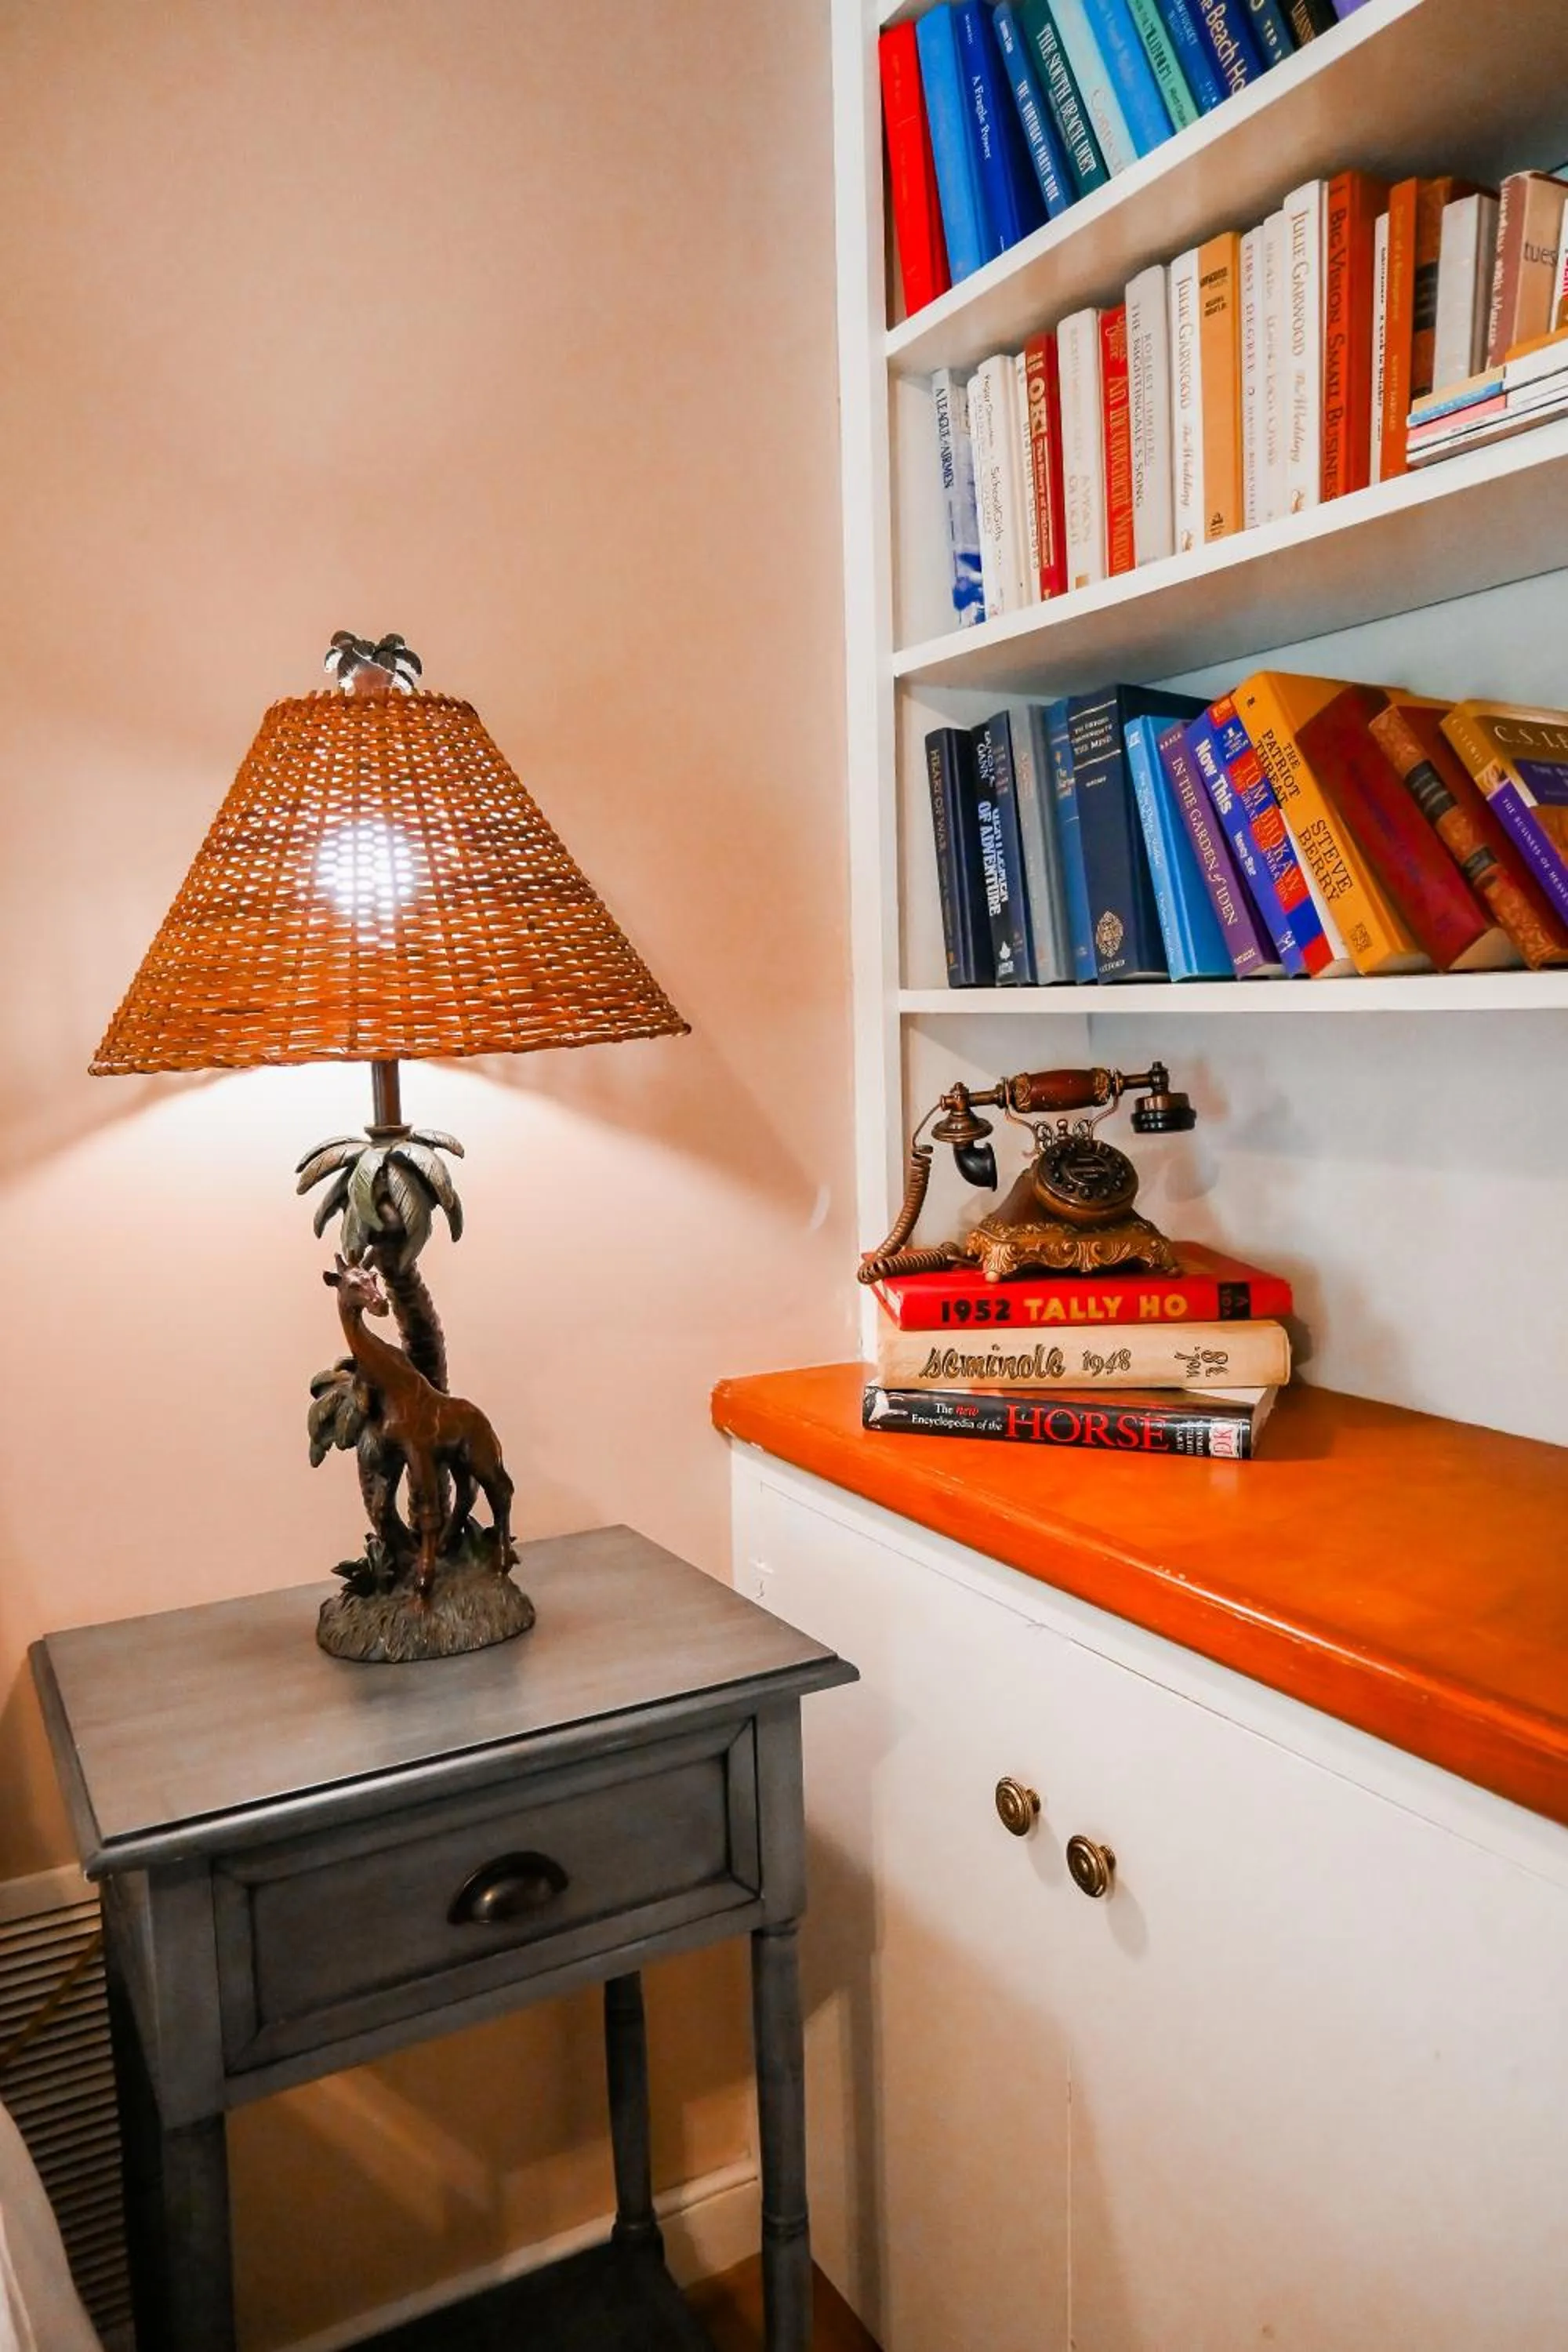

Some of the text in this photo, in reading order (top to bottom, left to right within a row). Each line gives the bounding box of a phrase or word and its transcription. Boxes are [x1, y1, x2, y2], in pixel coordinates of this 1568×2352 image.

[1205, 3, 1240, 72] Beach
[1045, 53, 1072, 103] SOUTH
[1060, 96, 1086, 146] BEACH
[980, 124, 992, 158] Power
[1290, 209, 1309, 356] JULIE GARWOOD
[1175, 275, 1193, 409] JULIE GARWOOD
[1244, 303, 1255, 374] DEGREE
[1326, 332, 1344, 403] SMALL
[935, 388, 945, 397] A
[937, 395, 952, 441] LEAGUE
[941, 445, 954, 489] AIRMEN
[1134, 463, 1145, 508] SONG
[1194, 739, 1234, 816] Now This
[1255, 739, 1287, 804] THREAT
[1261, 728, 1301, 798] PATRIOT
[1283, 742, 1301, 769] THE
[1172, 757, 1186, 777] IN
[1179, 775, 1197, 808] THE
[1189, 808, 1218, 877] GARDEN
[1216, 881, 1239, 926] IDEN
[1241, 757, 1302, 891] TOM BROKAW
[1310, 819, 1354, 895] STEVE
[976, 800, 1002, 916] OF ADVENTURE
[1298, 827, 1341, 902] BERRY
[942, 1294, 1188, 1323] 1952 TALLY HO
[1082, 1348, 1132, 1377] 1948
[912, 1414, 1003, 1431] Encyclopedia of the
[935, 1403, 978, 1417] The new
[1004, 1403, 1170, 1450] HORSE
[1212, 1428, 1234, 1455] DK
